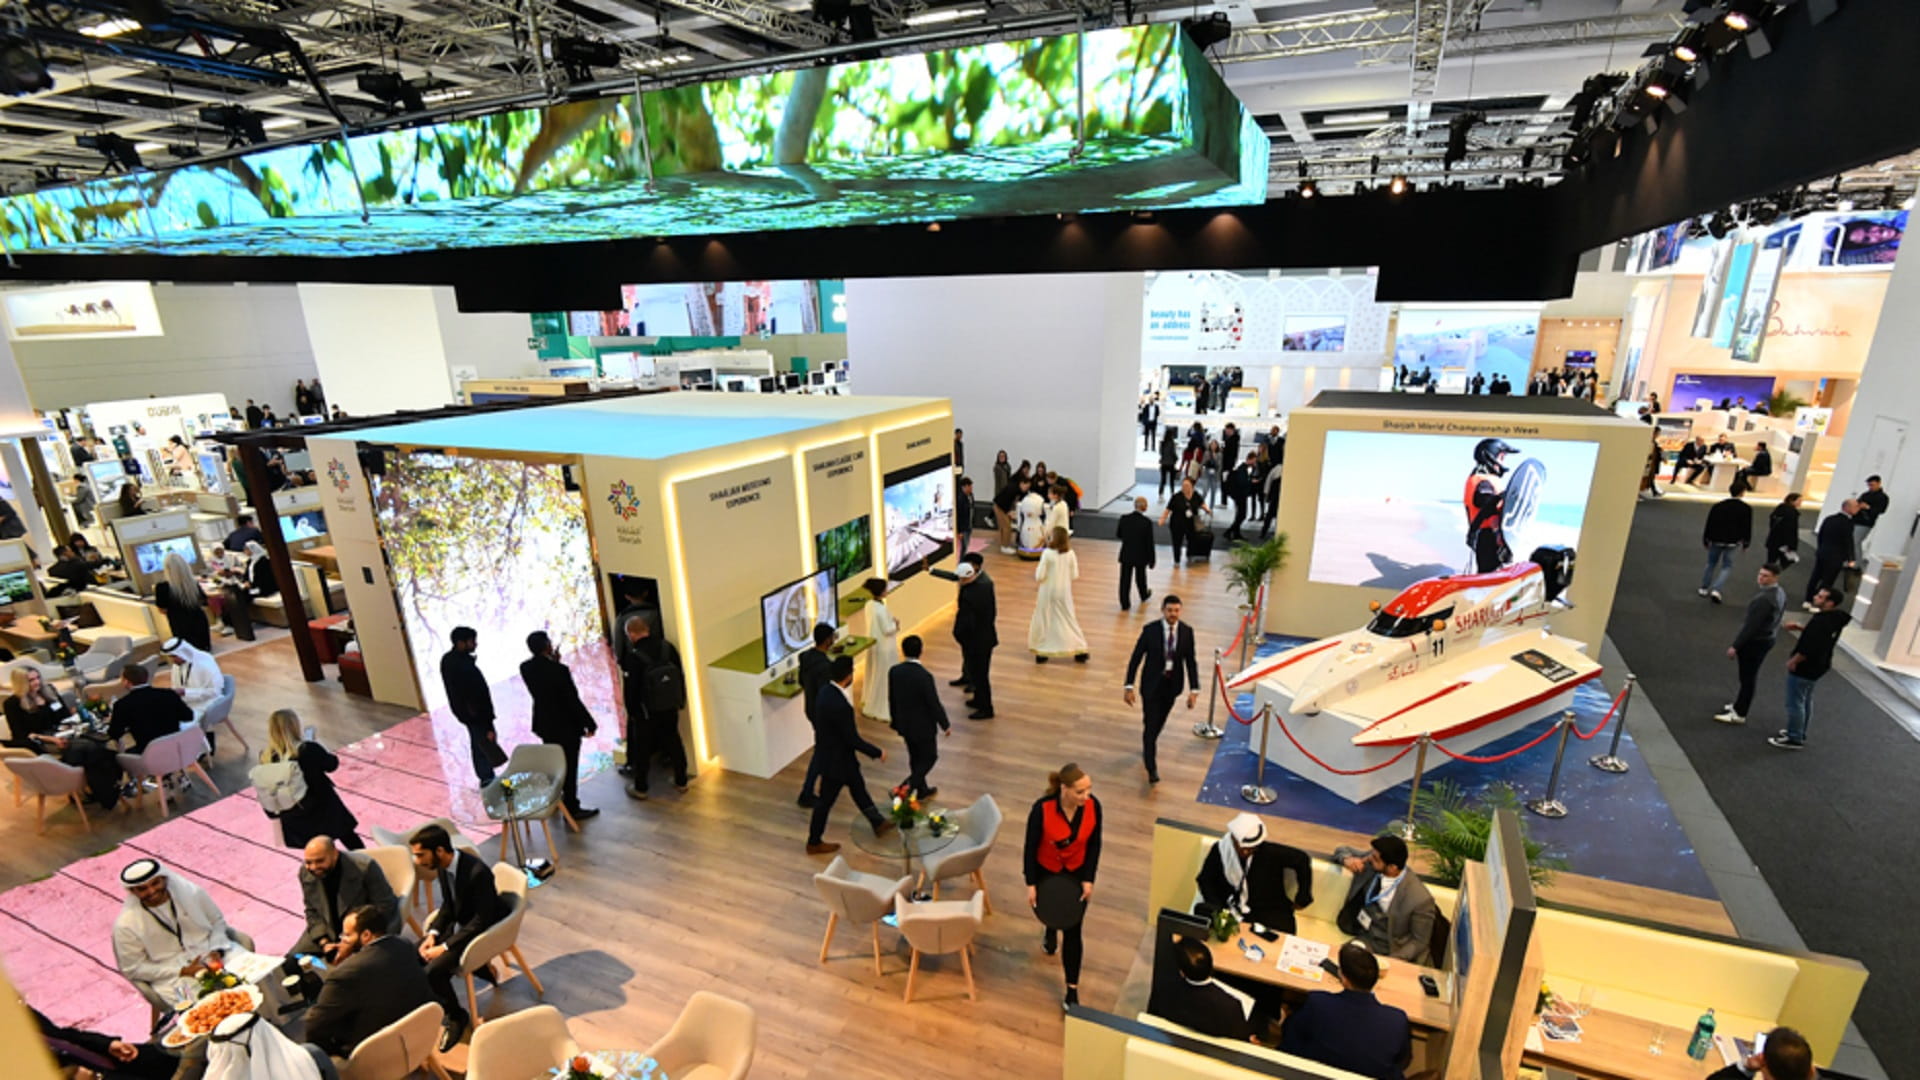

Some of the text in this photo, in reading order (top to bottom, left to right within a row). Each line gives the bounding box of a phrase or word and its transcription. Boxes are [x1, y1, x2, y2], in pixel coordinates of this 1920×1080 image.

[1418, 421, 1444, 432] World
[1513, 425, 1539, 435] Week
[1432, 637, 1445, 657] 11
